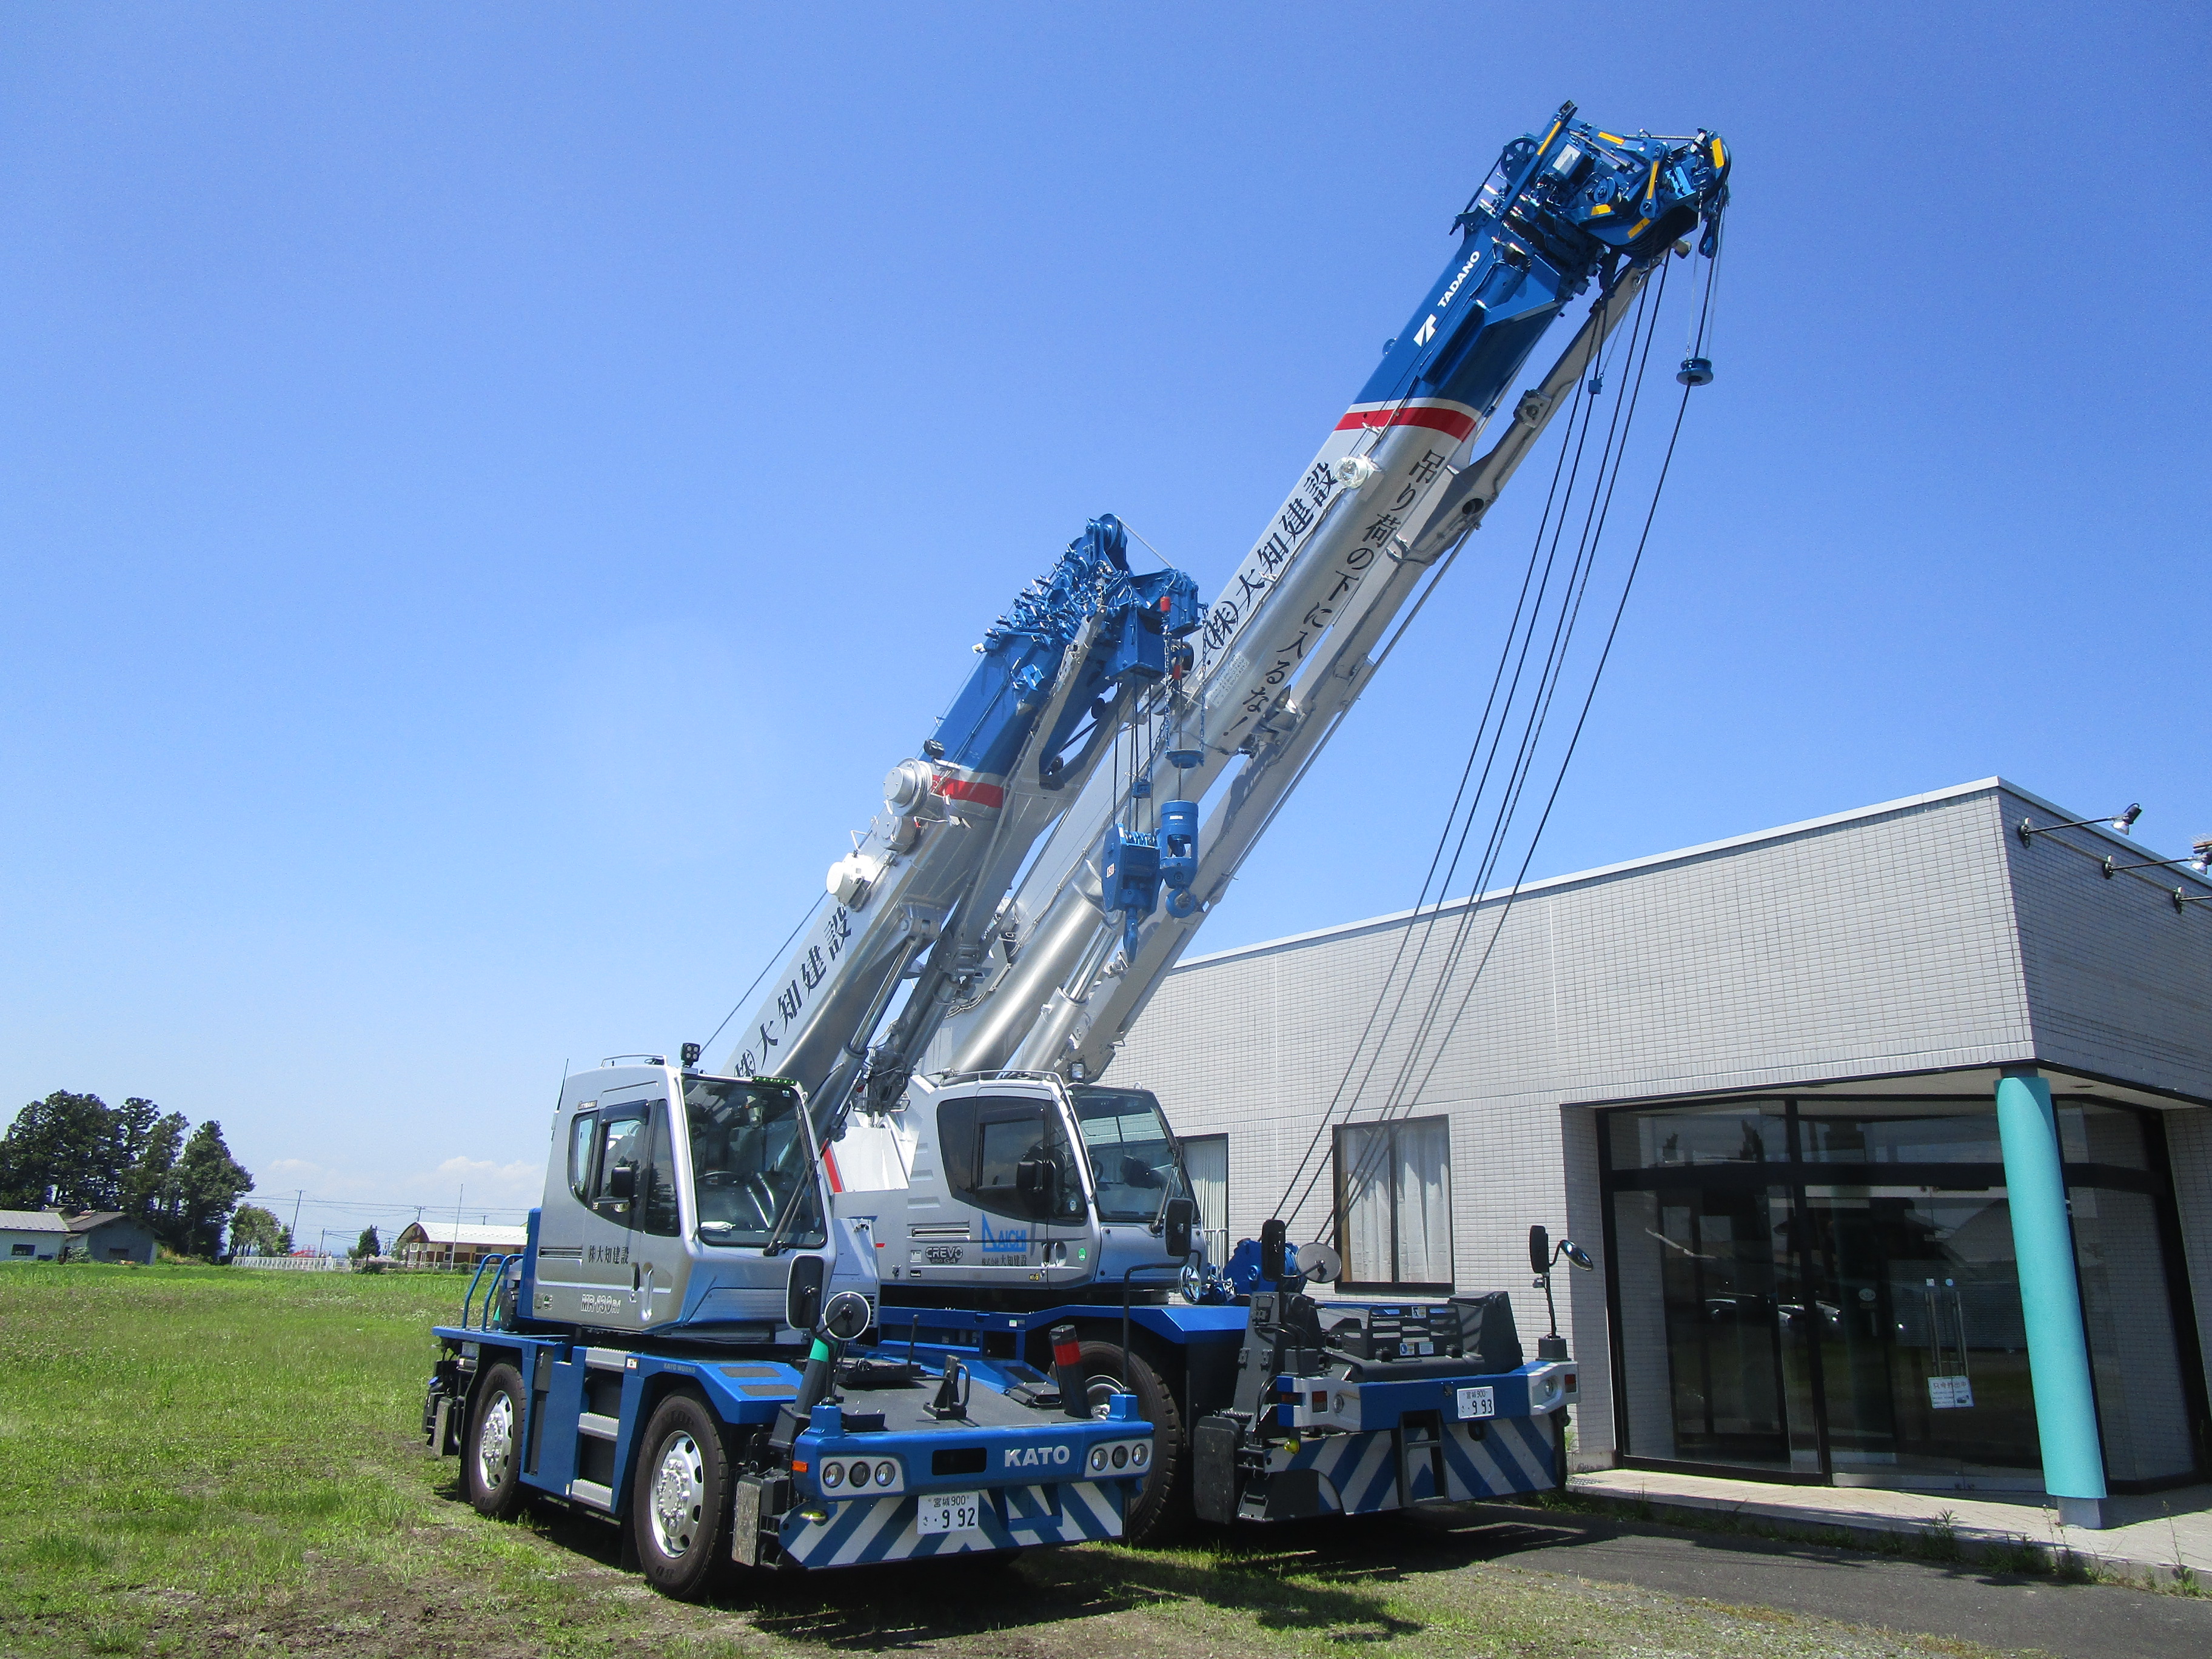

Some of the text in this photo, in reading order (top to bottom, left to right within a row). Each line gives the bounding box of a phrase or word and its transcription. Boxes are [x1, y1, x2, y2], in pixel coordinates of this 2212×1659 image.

[1437, 250, 1480, 307] TADANO
[1205, 462, 1338, 649] (株)大知建設
[925, 1247, 963, 1258] CREVO
[1005, 1446, 1070, 1467] KATO
